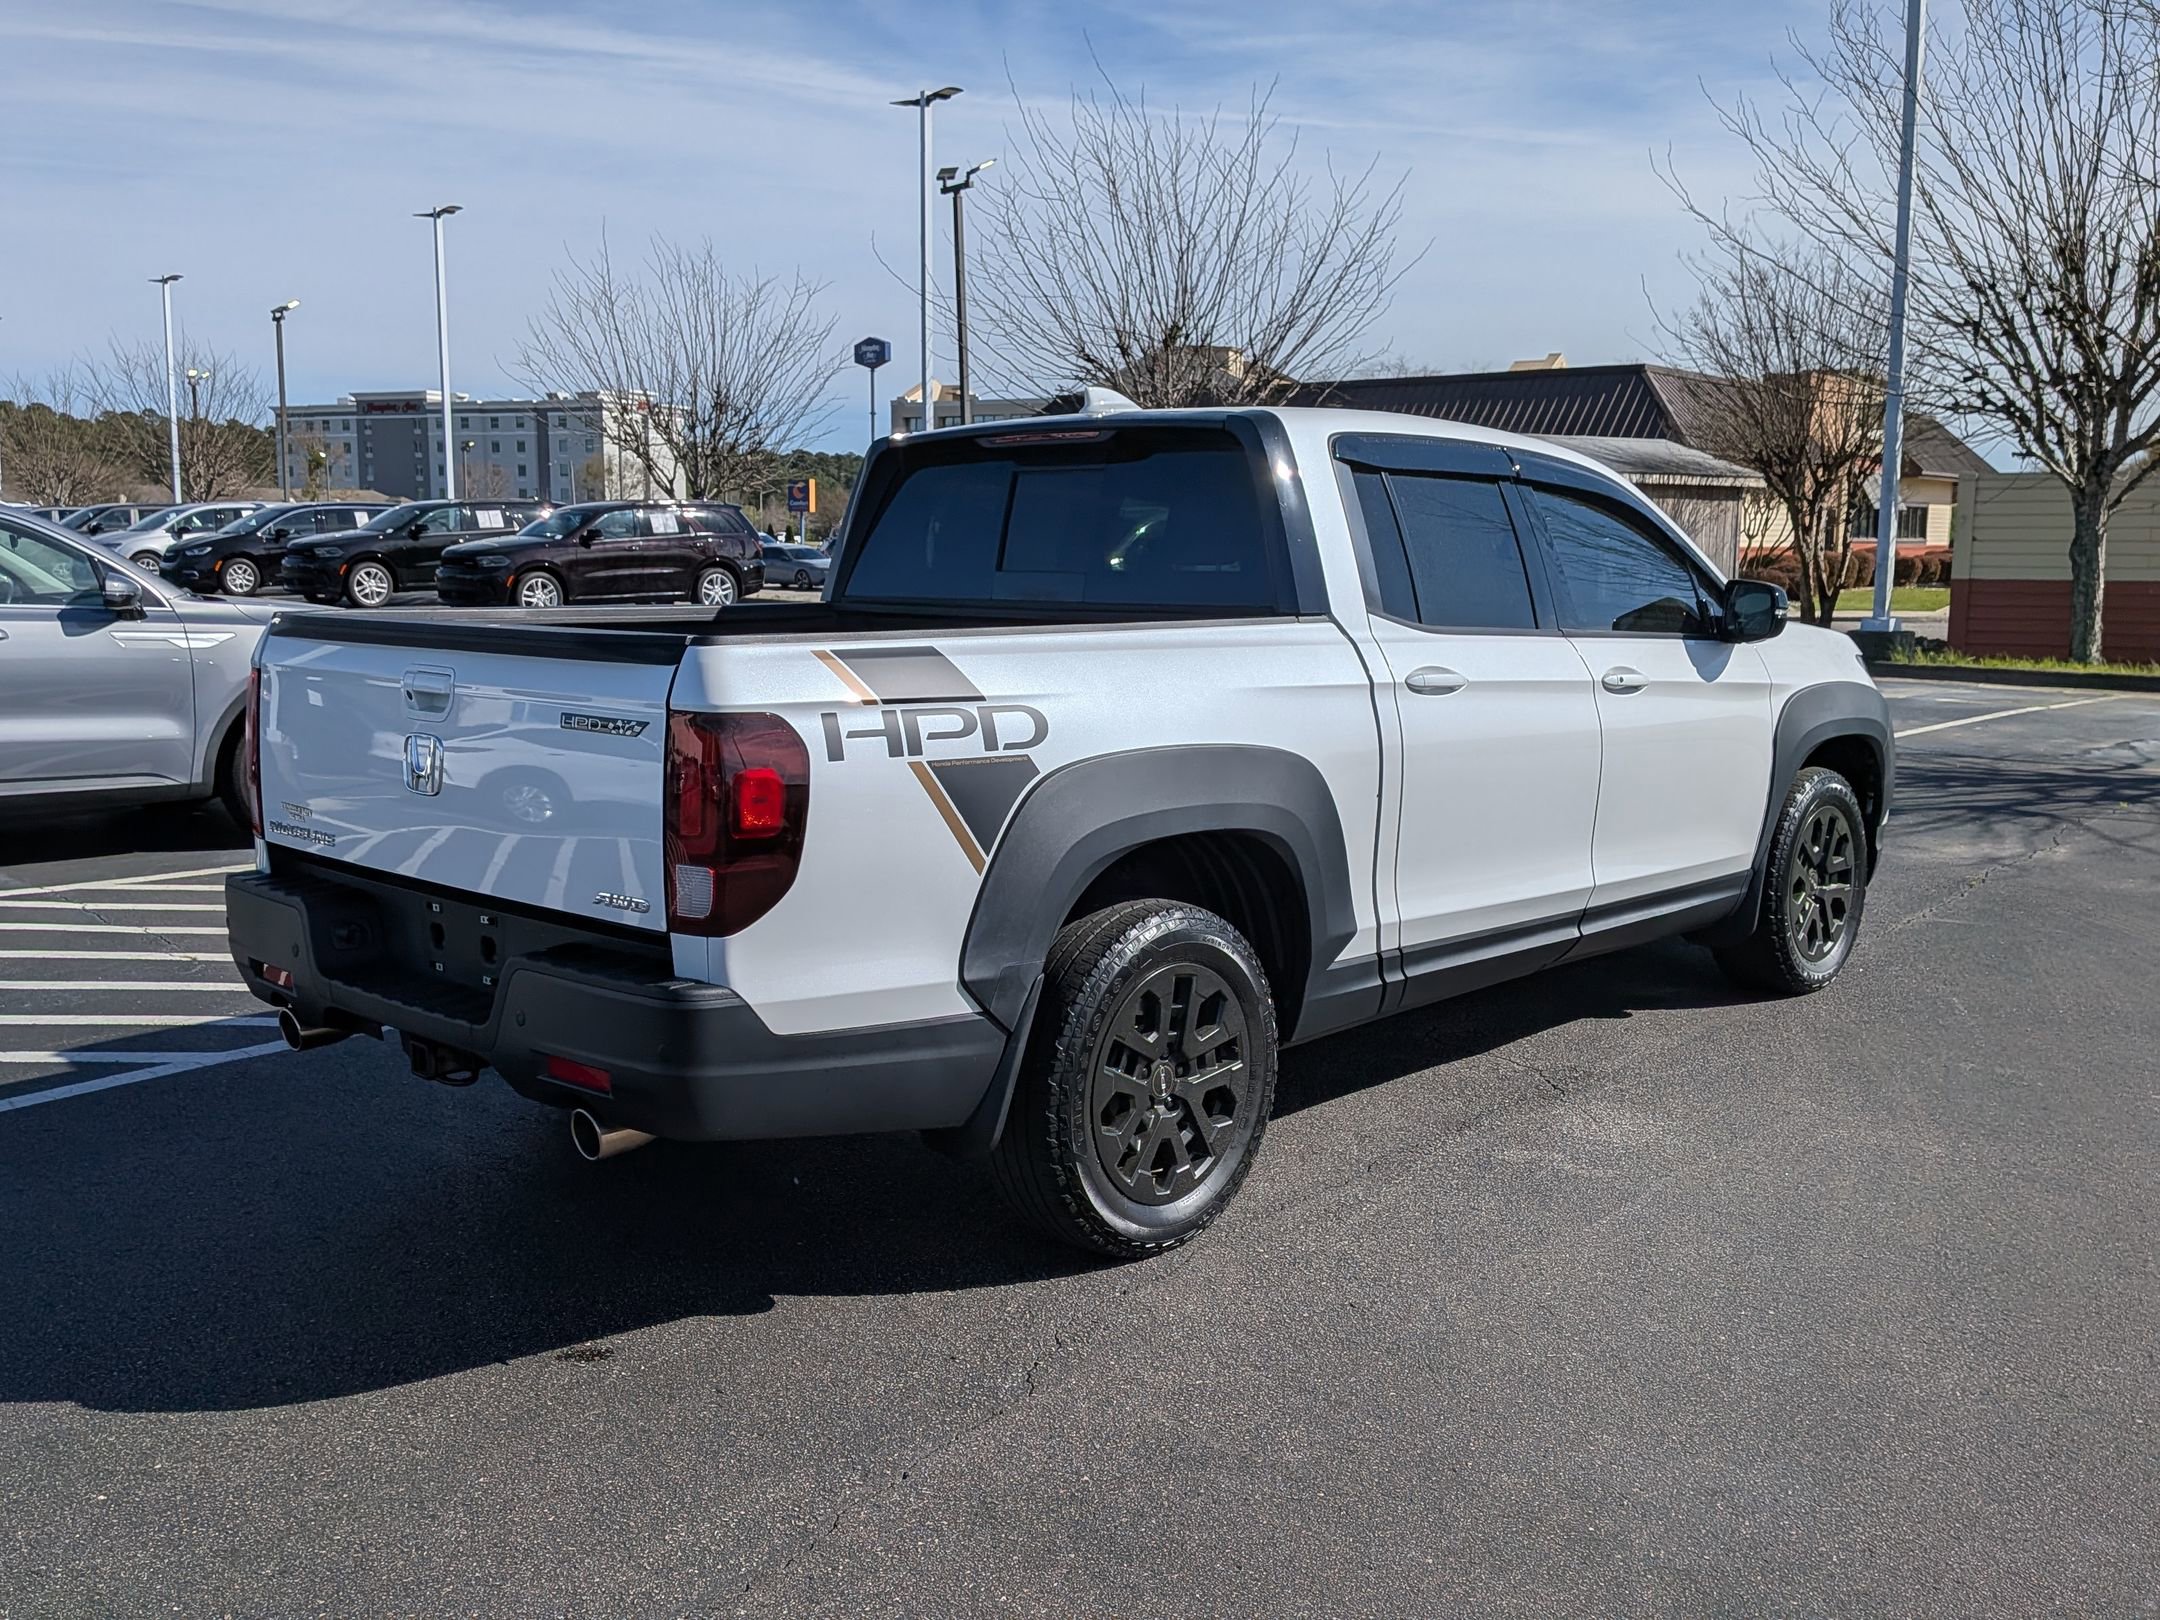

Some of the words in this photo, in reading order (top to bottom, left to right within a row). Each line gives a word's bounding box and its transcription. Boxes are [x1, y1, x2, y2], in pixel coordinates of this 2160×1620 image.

[561, 714, 602, 731] HPD
[820, 704, 1049, 762] HPD
[951, 758, 990, 767] Performance
[990, 755, 1029, 765] Development
[592, 892, 651, 914] AWD
